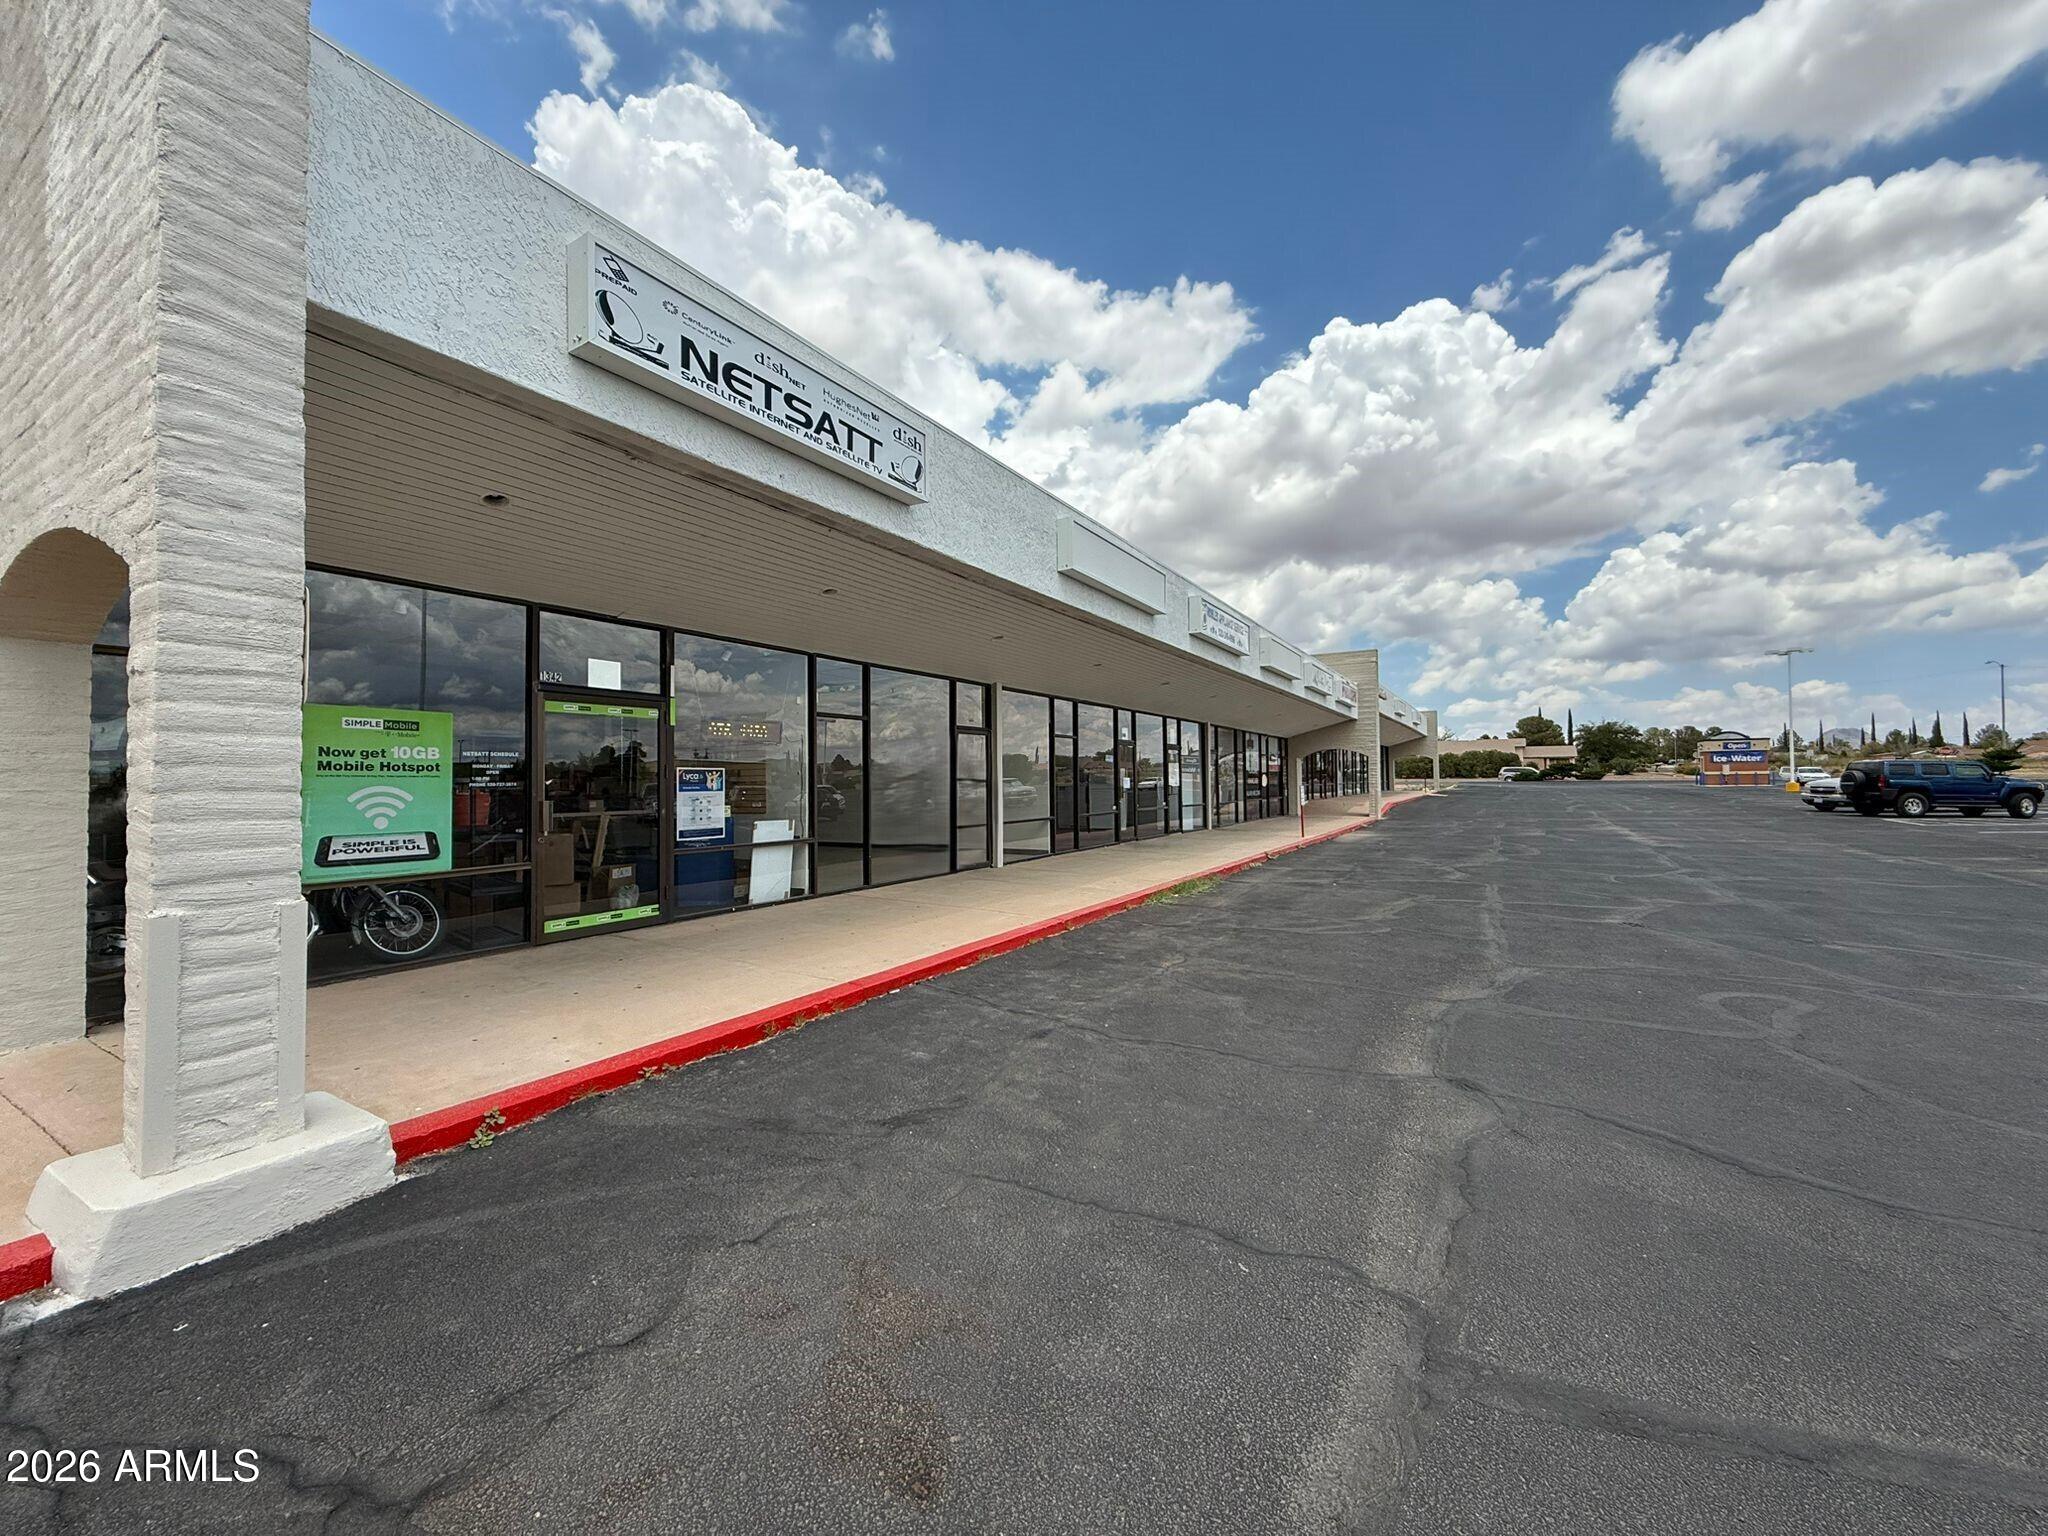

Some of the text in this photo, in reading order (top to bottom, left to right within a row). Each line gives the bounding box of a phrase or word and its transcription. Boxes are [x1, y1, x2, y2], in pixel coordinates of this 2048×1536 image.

[595, 268, 637, 296] PREPAID
[681, 312, 733, 344] CenturyLink
[681, 334, 883, 463] NETSATT
[823, 388, 871, 421] HughesNet
[681, 370, 746, 409] SATELLITE
[749, 403, 800, 435] INTERNET
[803, 431, 823, 446] AND
[825, 441, 870, 469] SATELLITE
[872, 462, 883, 475] TV
[892, 427, 922, 452] dish
[540, 671, 562, 683] 1342
[344, 719, 418, 731] SIMPLE Mobile
[318, 746, 440, 760] Now get 10GB
[316, 760, 440, 774] Mobile Hotspot
[331, 844, 426, 855] POWERFUL
[342, 839, 399, 848] SIMPLE
